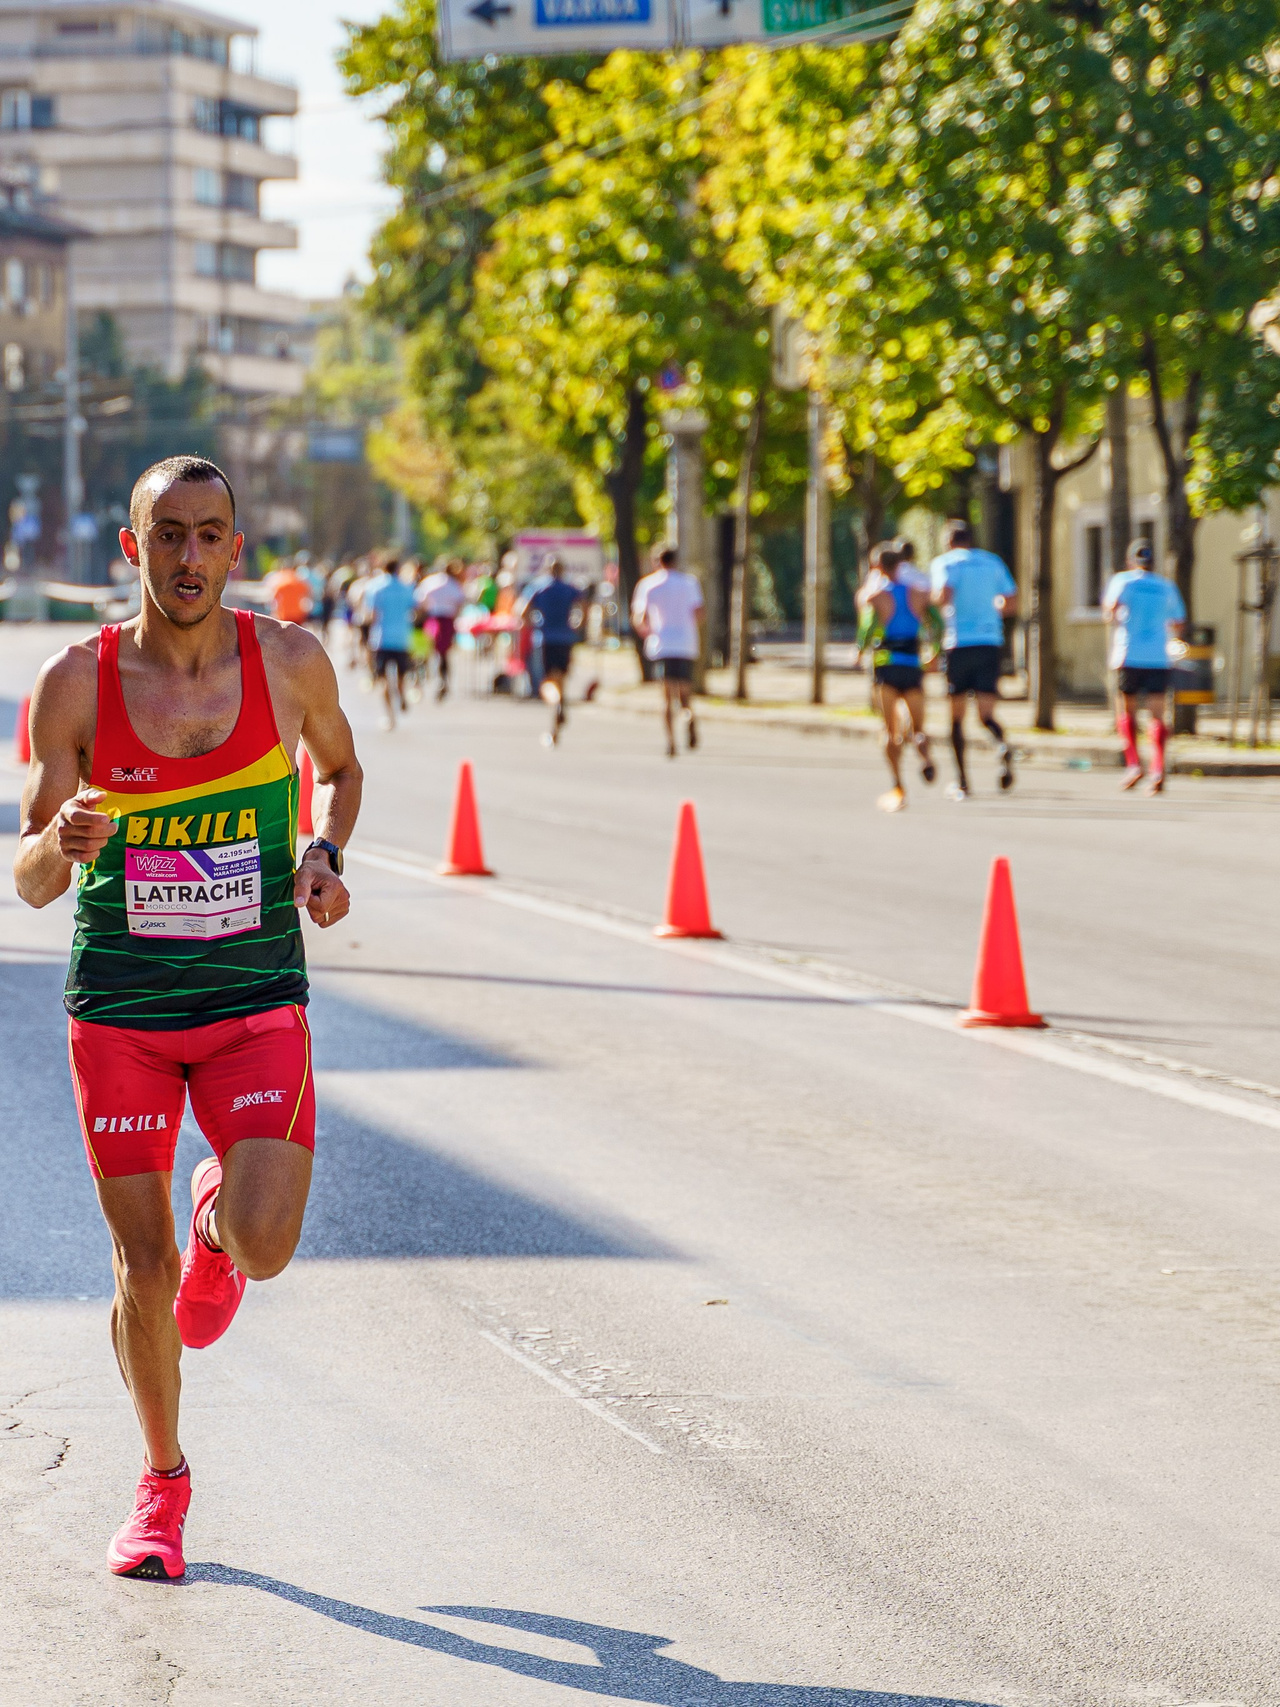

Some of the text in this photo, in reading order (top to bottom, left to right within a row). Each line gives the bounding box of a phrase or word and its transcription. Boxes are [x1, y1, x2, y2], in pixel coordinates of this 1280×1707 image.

[111, 767, 159, 775] SWEET
[125, 808, 258, 847] BIKILA
[218, 849, 243, 859] 42.195
[213, 864, 229, 872] WIZZ
[240, 859, 258, 867] SOFIA
[213, 864, 258, 877] MARATHON 2023
[133, 877, 254, 903] LATRACHE
[93, 1113, 168, 1133] BIKILA
